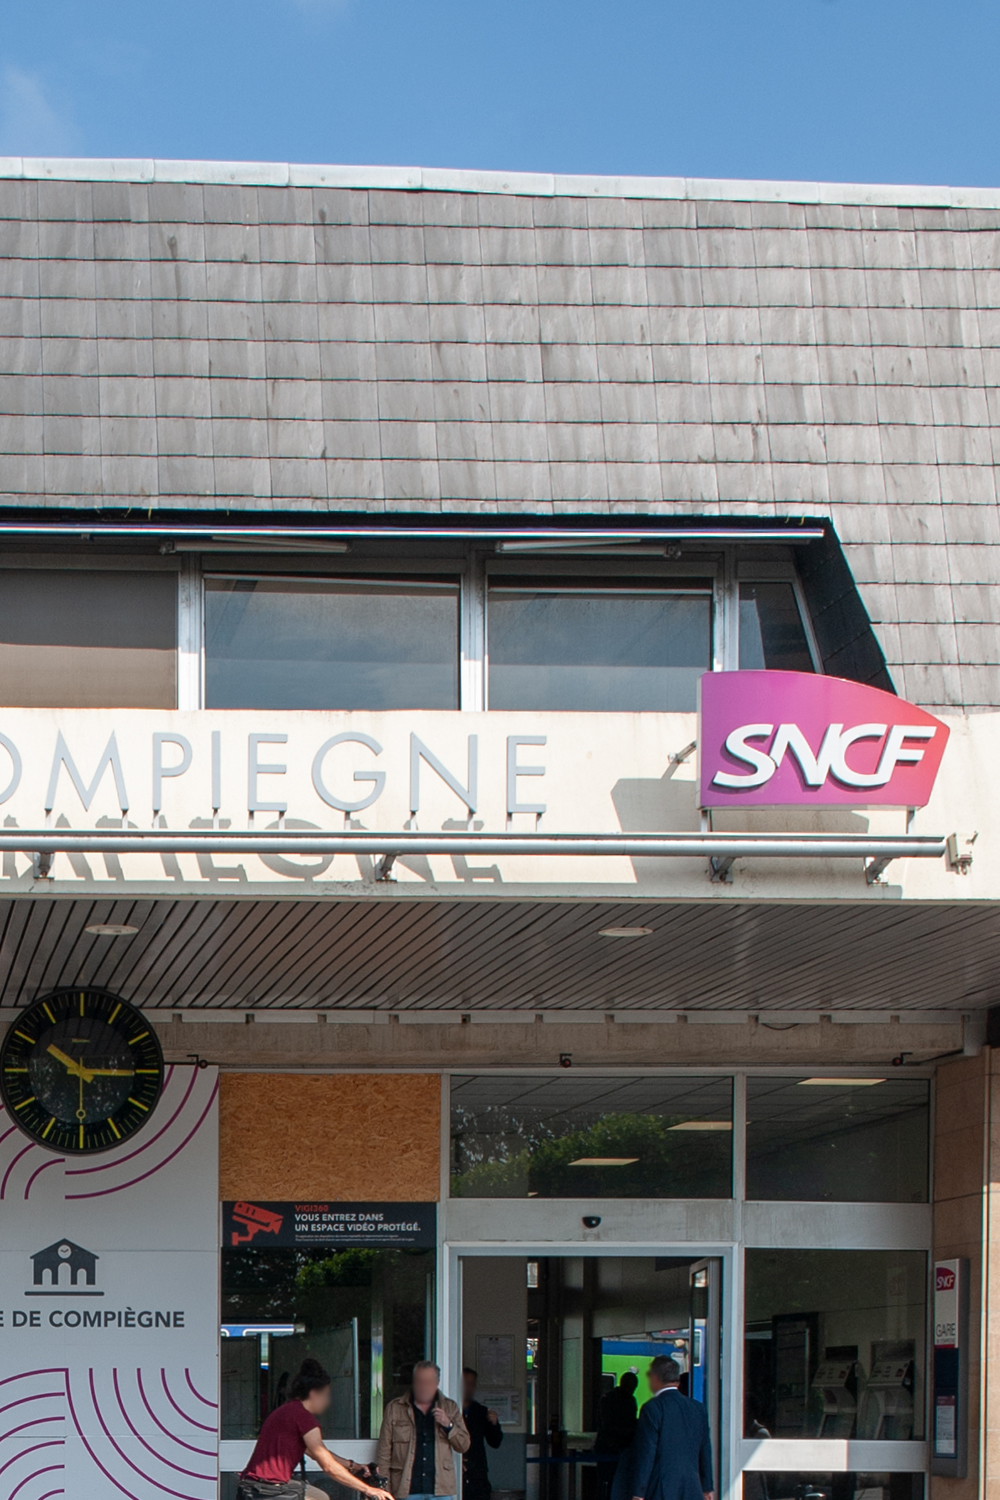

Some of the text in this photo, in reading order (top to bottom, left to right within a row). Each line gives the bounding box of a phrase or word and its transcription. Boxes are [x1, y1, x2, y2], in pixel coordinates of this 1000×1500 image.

[712, 723, 937, 787] SNCF
[295, 1204, 329, 1212] VIGI360
[295, 1213, 384, 1221] VOUS ENTREZ DANS
[295, 1221, 421, 1232] UN ESPACE VIDÉO PROTÉGÉ.
[936, 1274, 955, 1289] SNCF
[12, 1310, 41, 1328] DE
[48, 1306, 185, 1328] COMPIÈGNE
[936, 1323, 955, 1337] GARE
